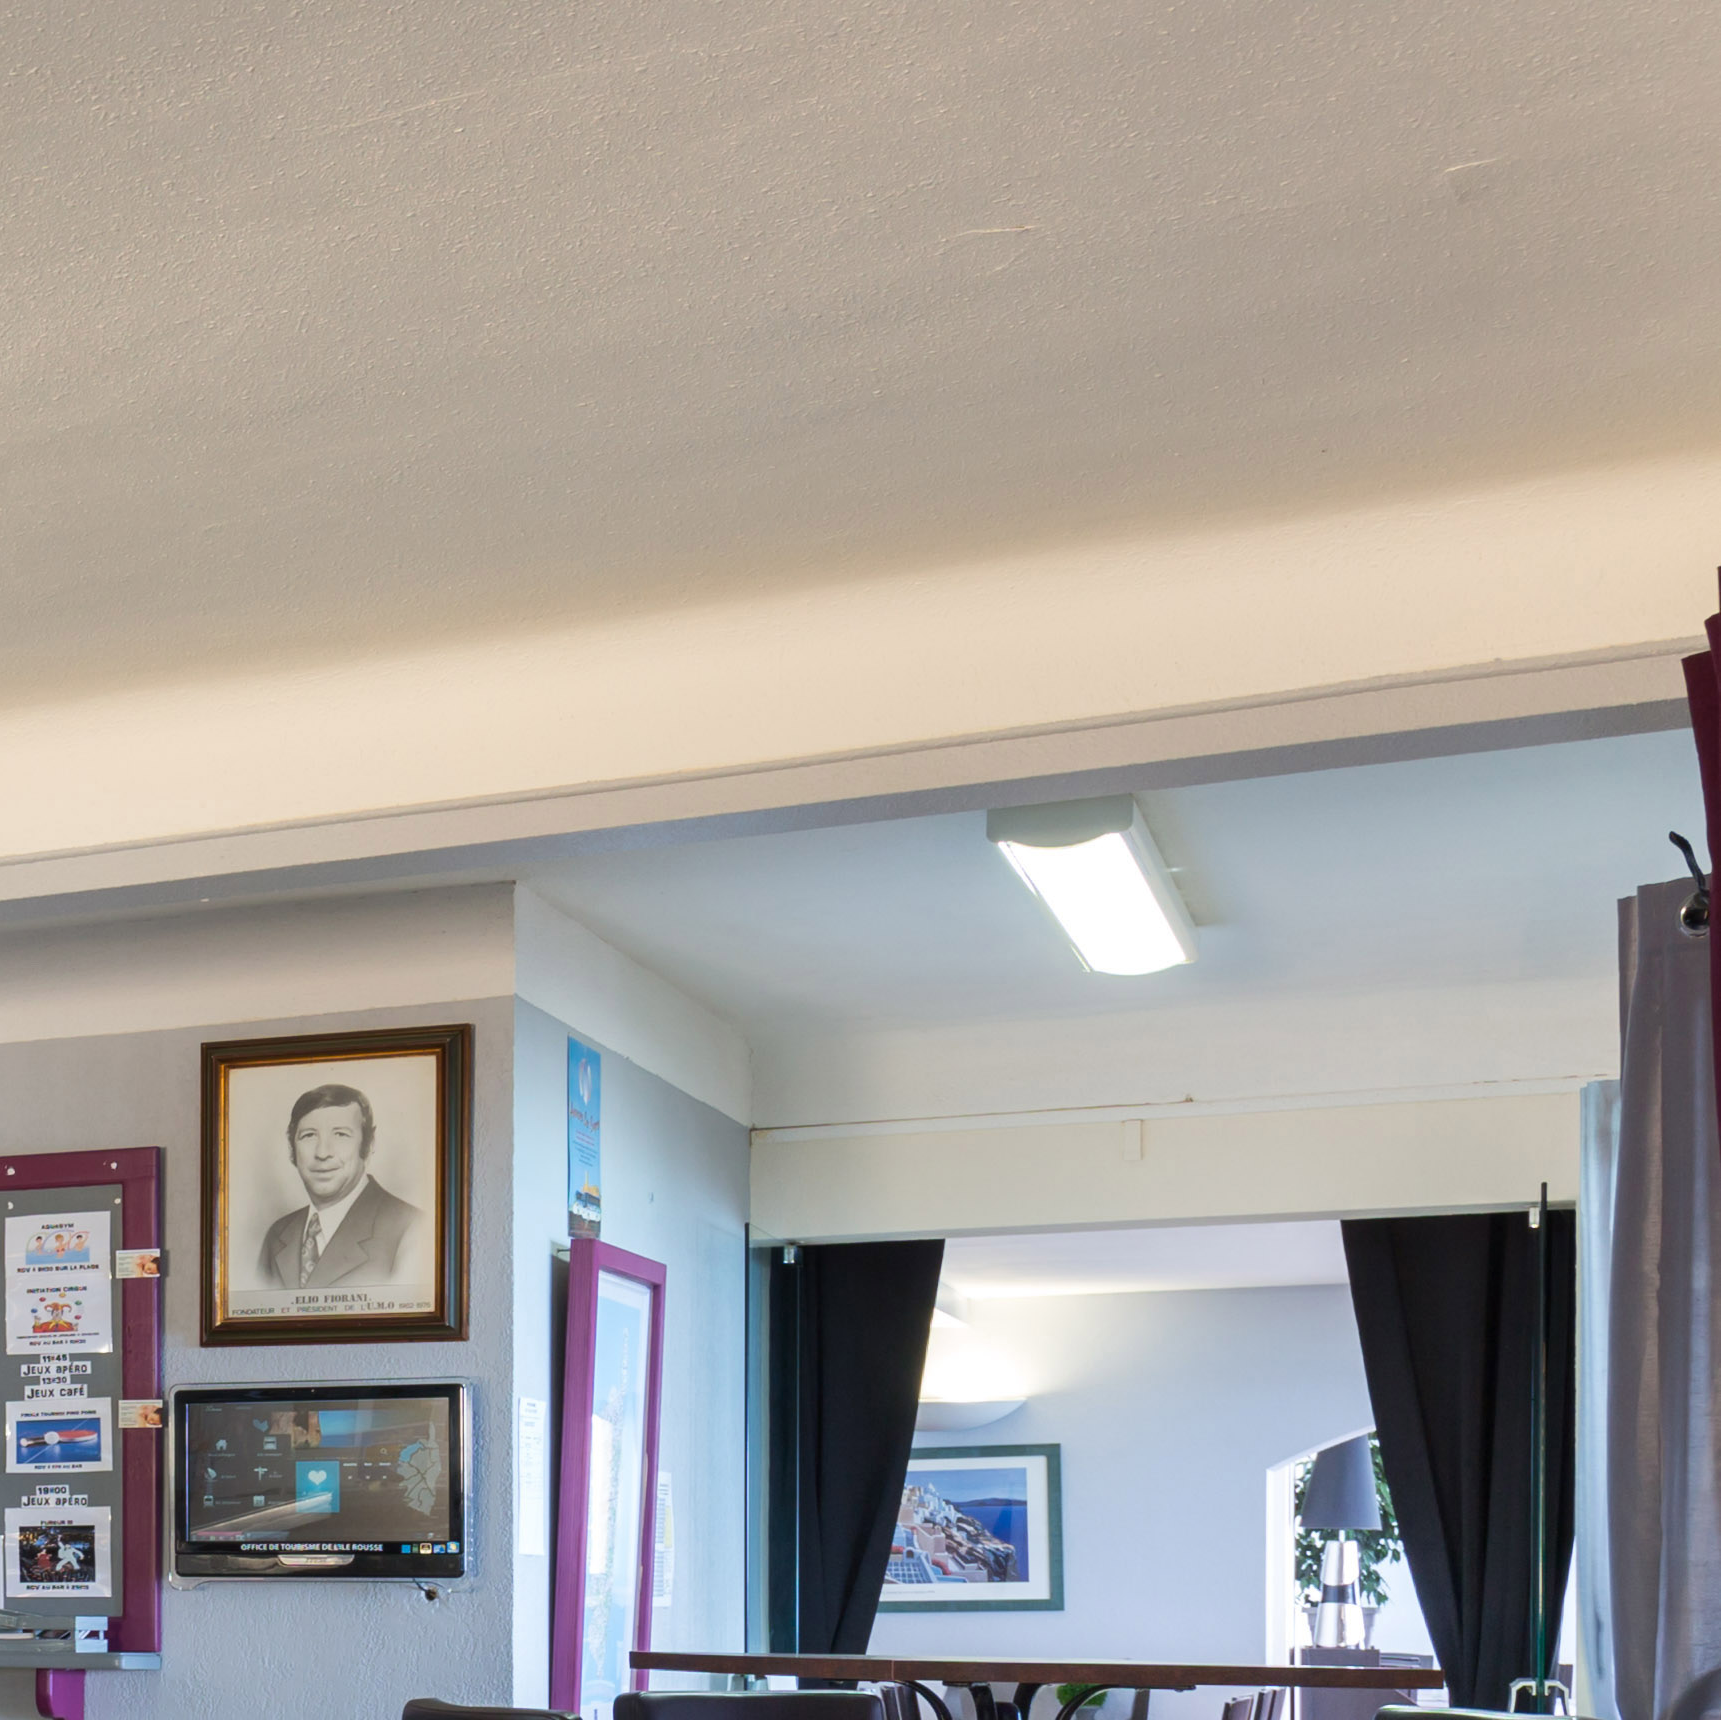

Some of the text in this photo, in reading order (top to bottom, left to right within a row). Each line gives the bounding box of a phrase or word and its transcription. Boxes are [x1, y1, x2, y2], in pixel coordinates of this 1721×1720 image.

[232, 1307, 275, 1316] FONDATEUR
[23, 1365, 51, 1375] JEUX
[27, 1388, 54, 1399] JEUX
[23, 1496, 50, 1506] JEUX
[269, 1543, 279, 1551] DE
